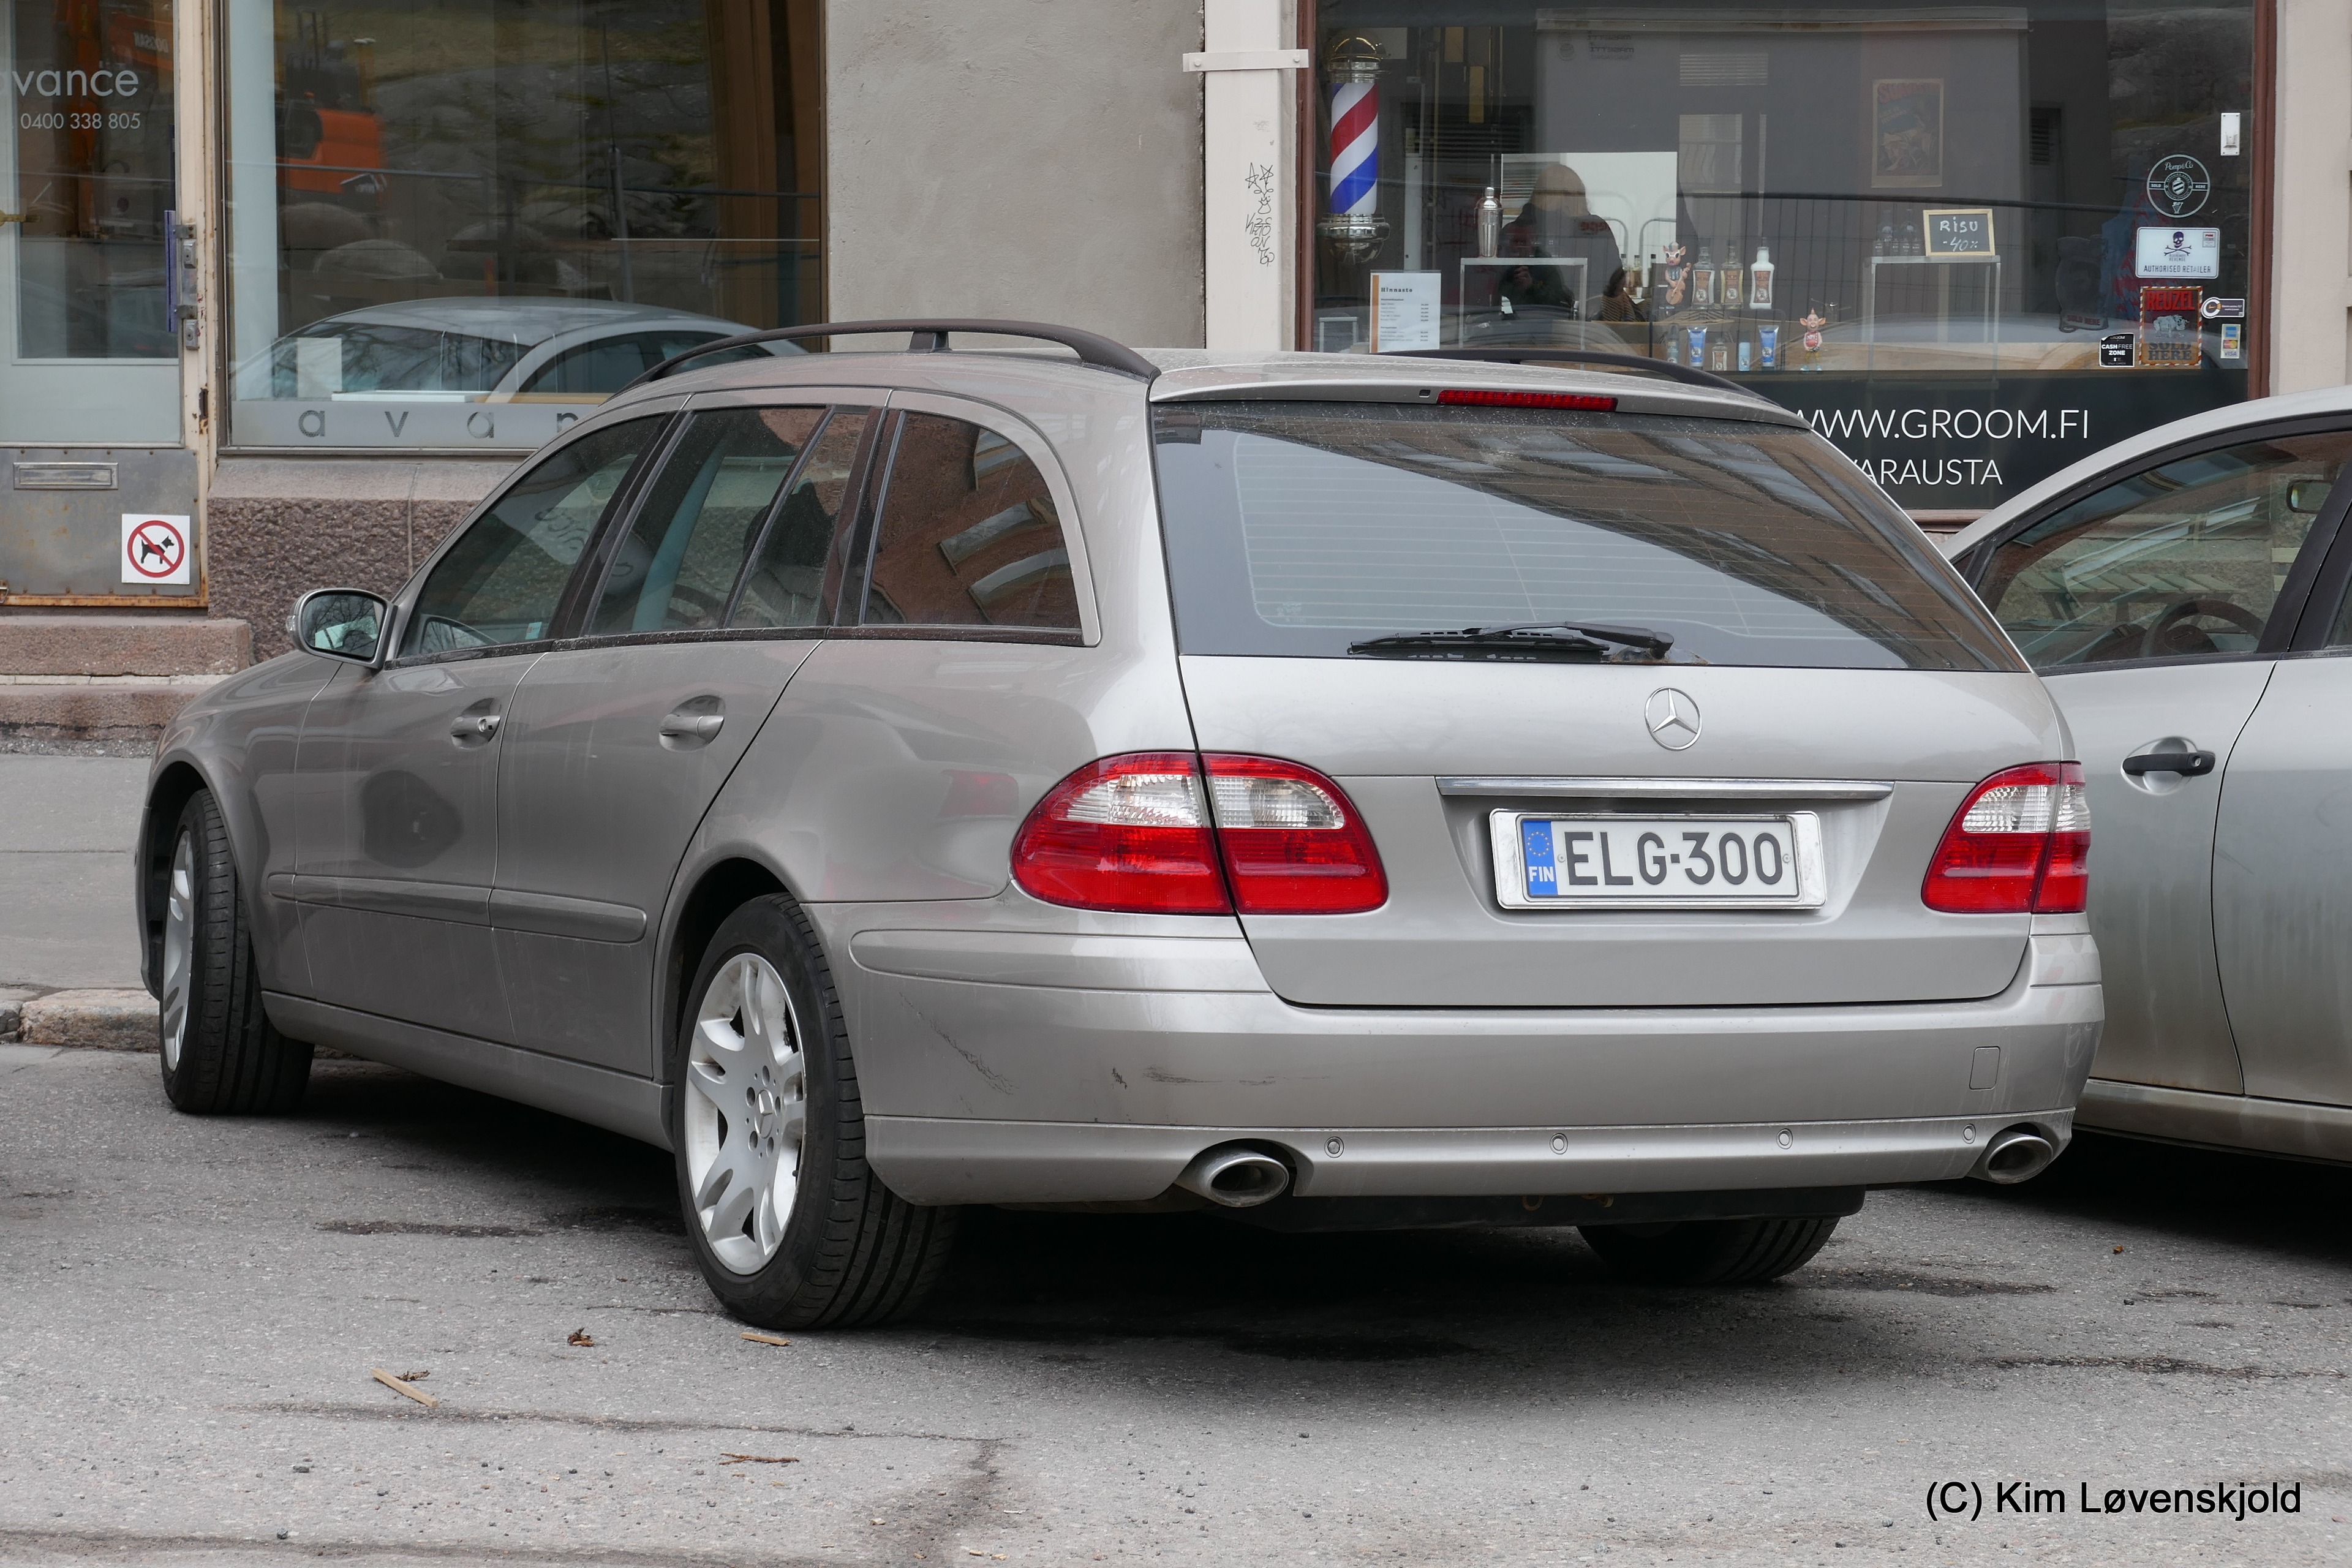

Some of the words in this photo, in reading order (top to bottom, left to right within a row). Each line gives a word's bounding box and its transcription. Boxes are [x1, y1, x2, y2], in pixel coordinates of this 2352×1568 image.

[20, 113, 64, 129] 0400
[70, 113, 102, 129] 338
[108, 113, 141, 129] 805
[2146, 291, 2195, 311] REUZEL
[2149, 342, 2192, 350] SOLD
[2149, 350, 2192, 360] HERE
[1855, 459, 2003, 485] ARAUSTA
[1564, 831, 1783, 886] ELG-300
[1529, 865, 1555, 882] FIN
